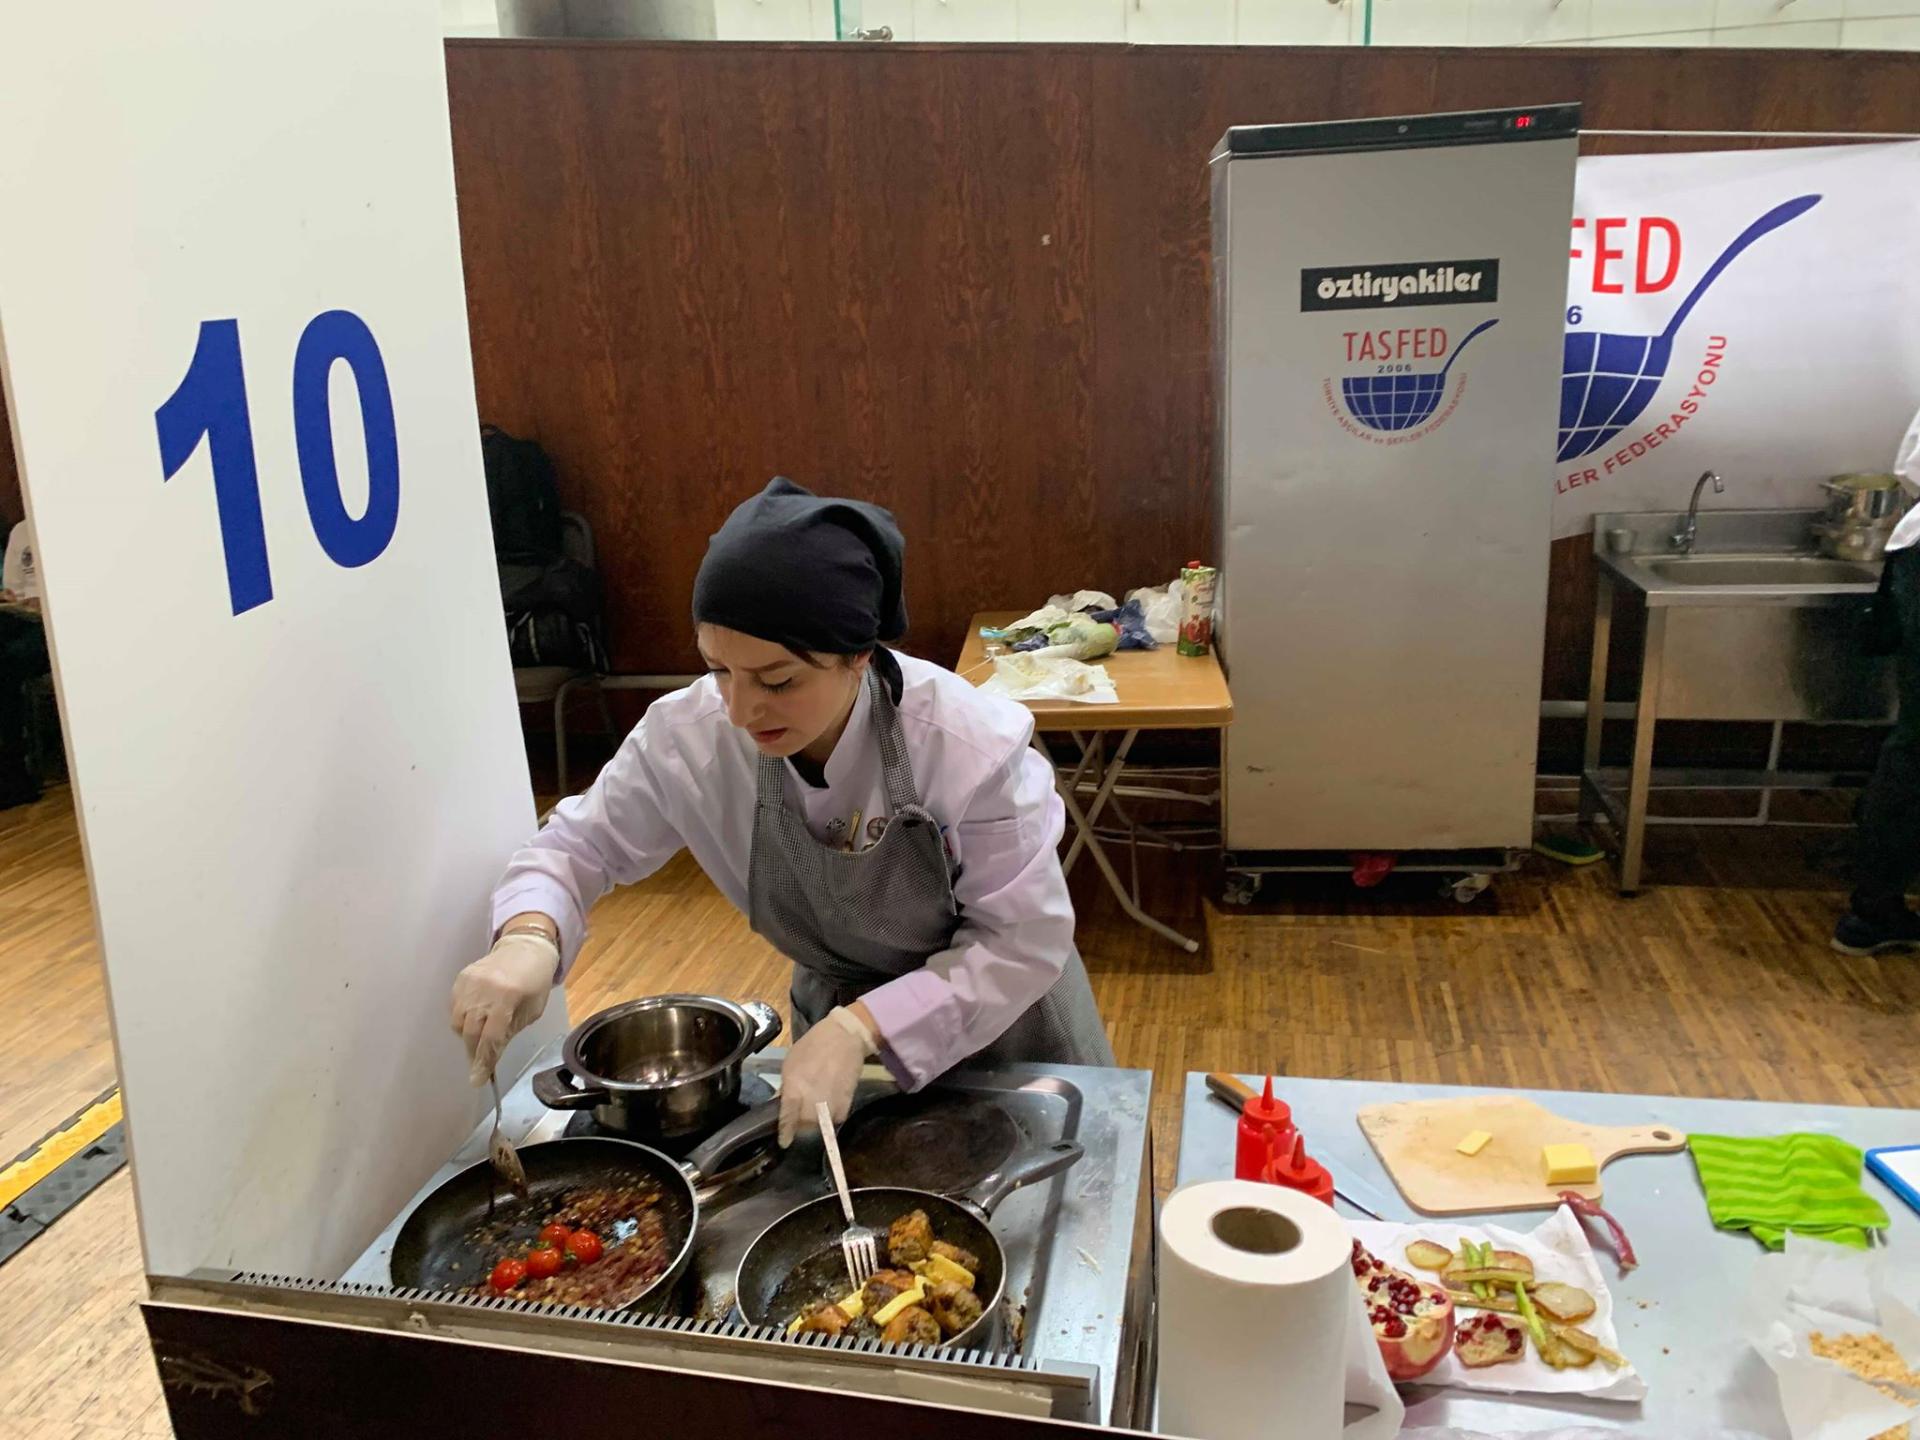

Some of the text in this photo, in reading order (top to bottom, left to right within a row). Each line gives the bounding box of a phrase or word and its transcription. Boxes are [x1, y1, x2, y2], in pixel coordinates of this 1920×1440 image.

[1317, 267, 1482, 302] öztiryakiler
[1343, 327, 1447, 361] TASFED
[1378, 364, 1412, 374] 2006
[1603, 335, 1727, 474] FEDERASYONU
[154, 309, 400, 616] 10
